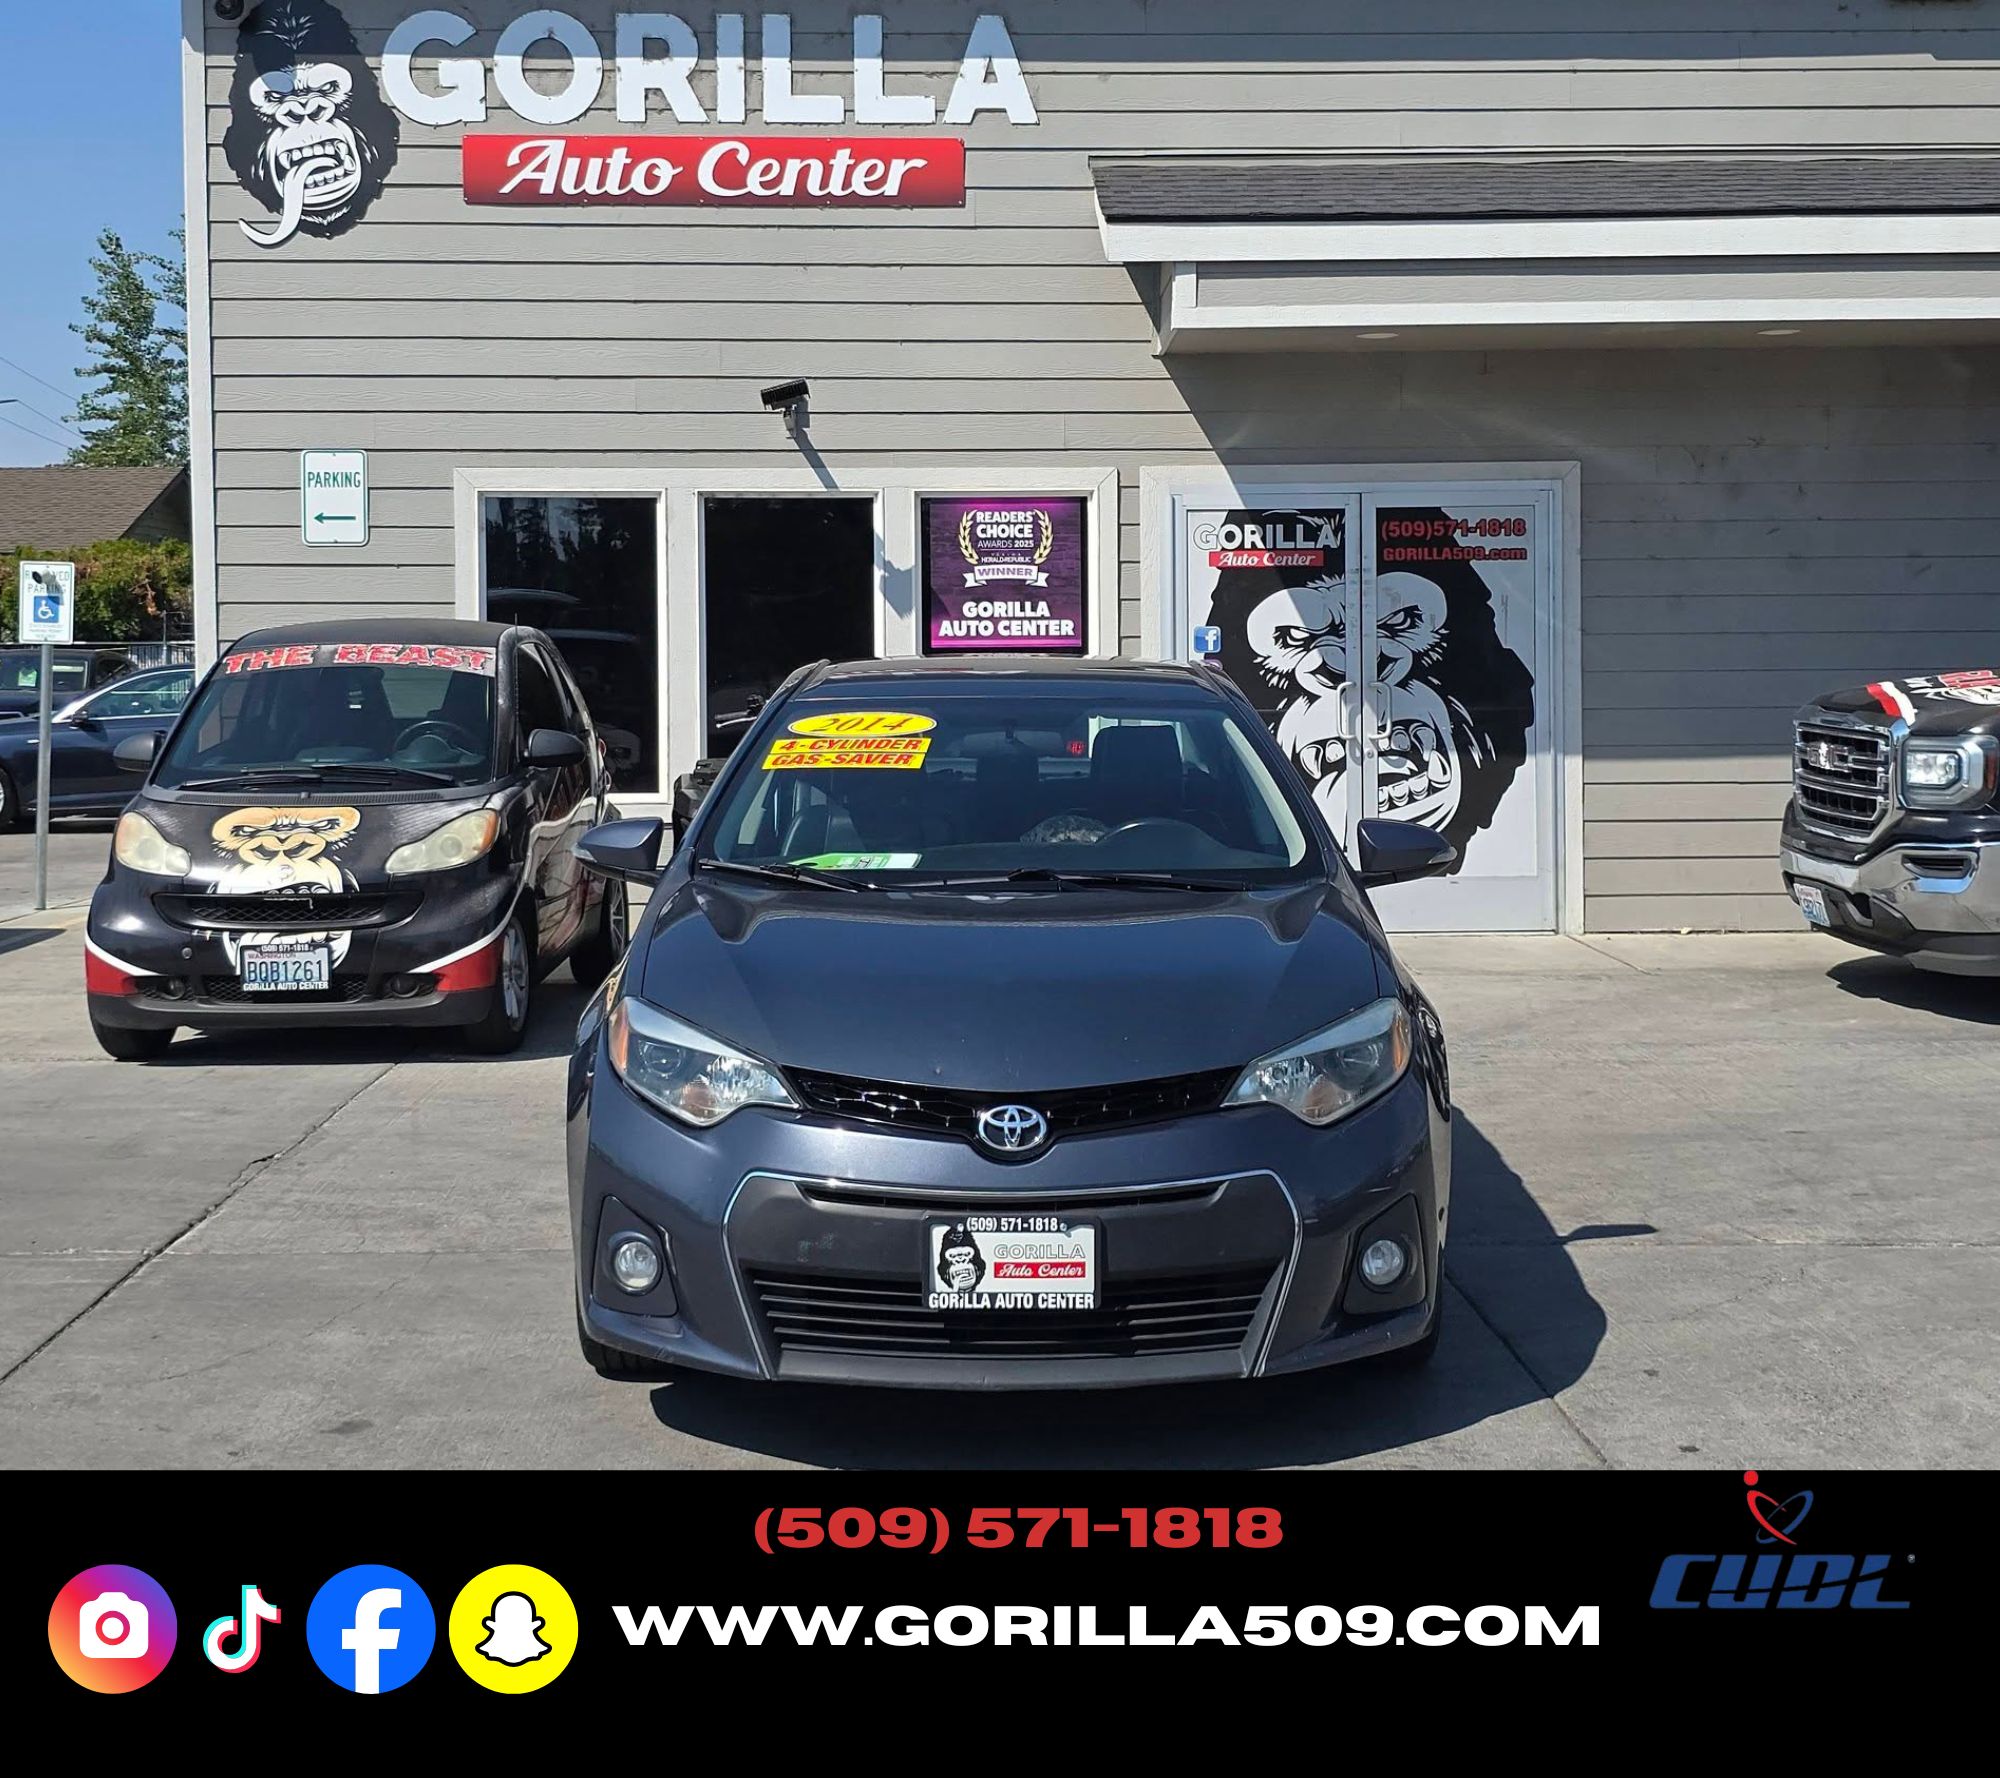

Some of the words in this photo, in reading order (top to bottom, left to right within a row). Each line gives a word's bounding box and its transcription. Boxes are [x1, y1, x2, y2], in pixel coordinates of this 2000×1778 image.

[381, 9, 1040, 128] GORILLA
[499, 138, 683, 197] Auto
[696, 139, 928, 198] Center
[307, 471, 361, 488] PARKING
[976, 511, 1036, 523] READERS'
[976, 524, 1034, 538] CHOICE
[1193, 523, 1339, 550] GORILLA
[977, 539, 1013, 548] AWARDS
[1014, 539, 1035, 548] 2025
[1218, 551, 1260, 566] Auto
[1263, 551, 1316, 566] Center
[1383, 546, 1528, 561] GORILLA509.com
[977, 567, 1033, 577] WINNER
[962, 601, 1050, 618] GORILLA
[938, 620, 994, 637] AUTO
[997, 619, 1075, 636] CENTER
[223, 645, 319, 675] THE
[334, 643, 495, 672] BEAST
[810, 717, 914, 732] 2014
[247, 960, 322, 982] BQB1261
[966, 1217, 997, 1231] (509)
[1000, 1217, 1058, 1231] 571-1818
[994, 1244, 1086, 1260] GORILLA
[998, 1264, 1034, 1277] Auto
[1038, 1264, 1083, 1277] Center
[928, 1293, 991, 1309] GORILLA
[995, 1293, 1034, 1309] AUTO
[1038, 1293, 1094, 1309] CENTER
